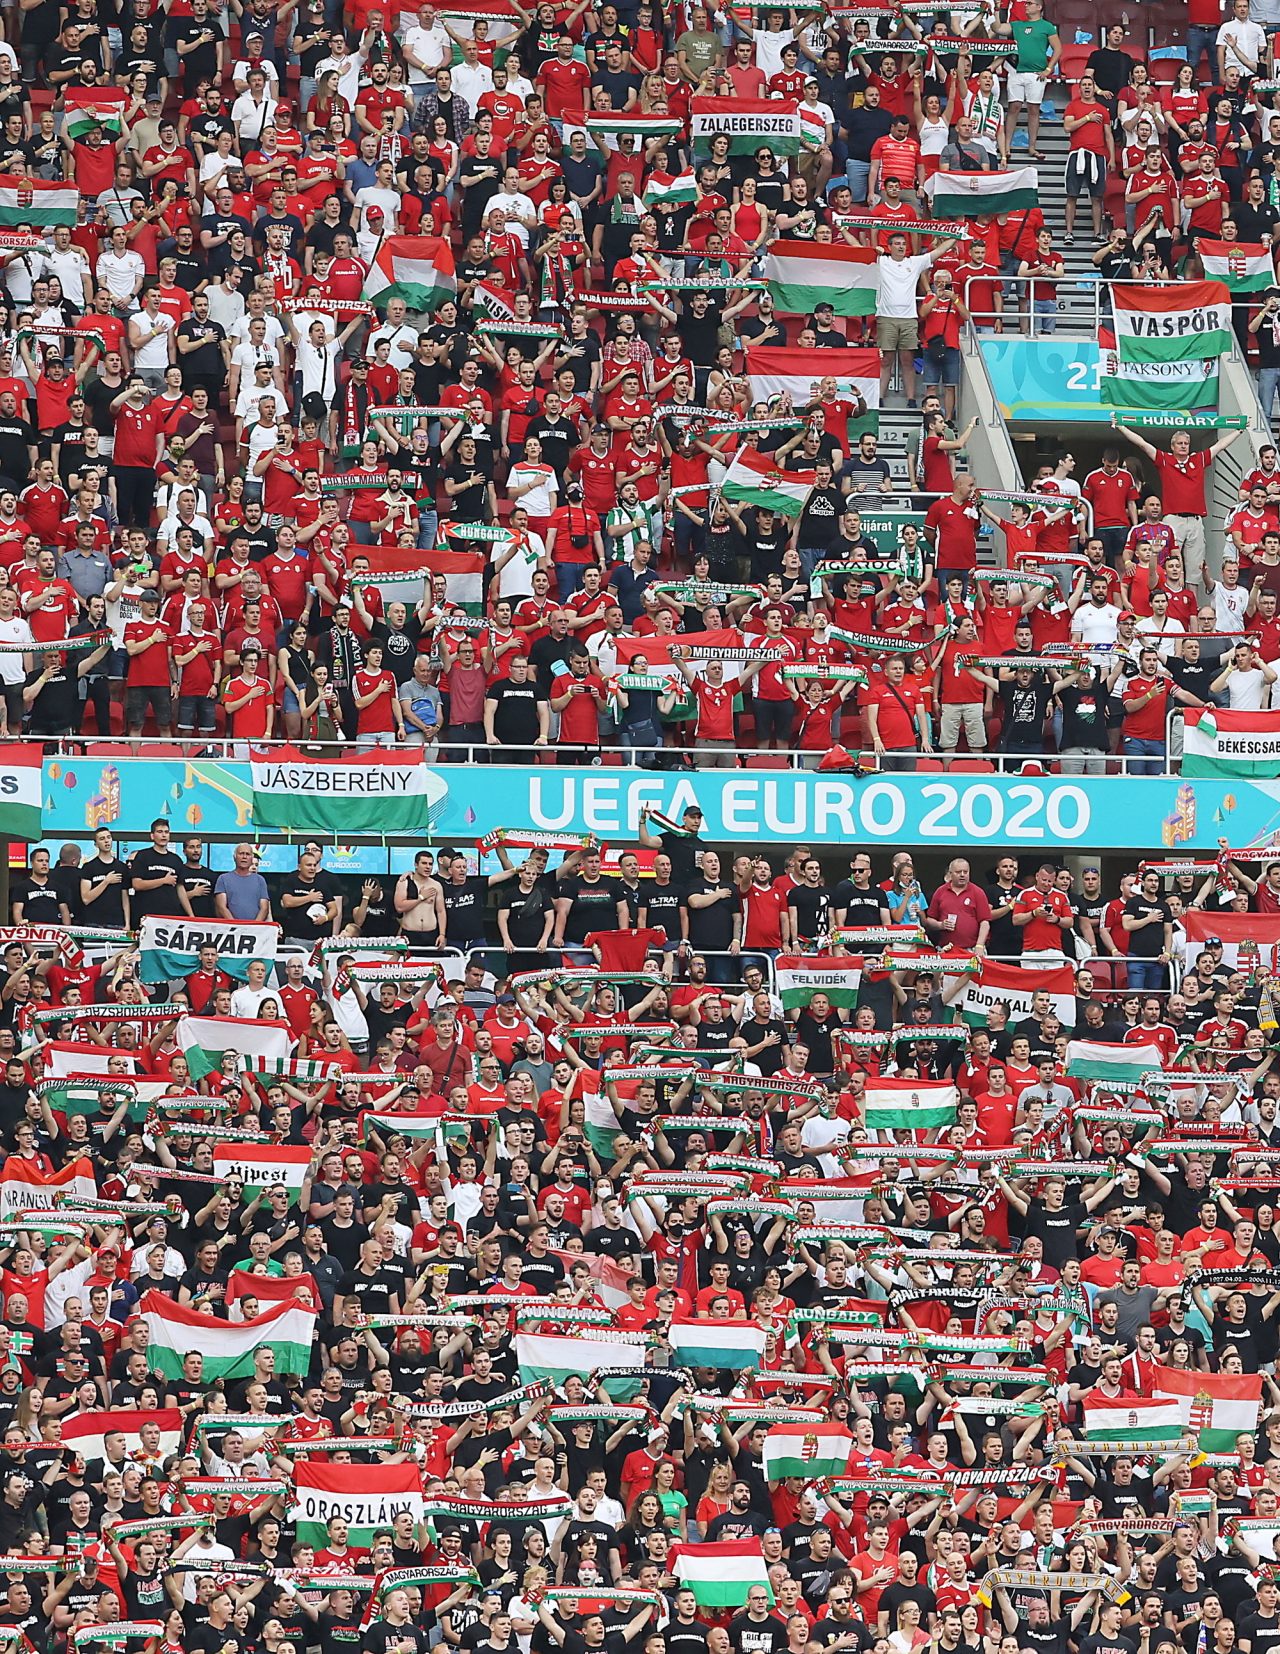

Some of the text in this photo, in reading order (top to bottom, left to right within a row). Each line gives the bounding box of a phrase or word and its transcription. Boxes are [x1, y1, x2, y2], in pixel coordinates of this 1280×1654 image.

[700, 118, 794, 133] ZALAEGERSZEG
[284, 298, 370, 312] MAGYARORSZ
[578, 294, 648, 305] HAJRÁ MAGYARORSZ
[1130, 311, 1220, 336] VASPÖR
[1143, 416, 1219, 427] HUNGARY
[884, 434, 897, 442] 12
[461, 526, 506, 540] HUNGARY
[859, 520, 893, 533] kijárat
[623, 676, 662, 688] HUNGARY
[0, 776, 18, 793] S
[260, 767, 412, 793] JÁSZBERÉNY
[529, 777, 1091, 840] UEFA EURO 2020
[154, 928, 256, 955] SÁRVÁR
[792, 973, 847, 985] FELVIDÉK
[966, 987, 1057, 1013] BUDAKALZ
[229, 1161, 288, 1184] Újpest
[797, 1308, 871, 1323] HUNGARY
[306, 1496, 413, 1523] OROSZLÁNY
